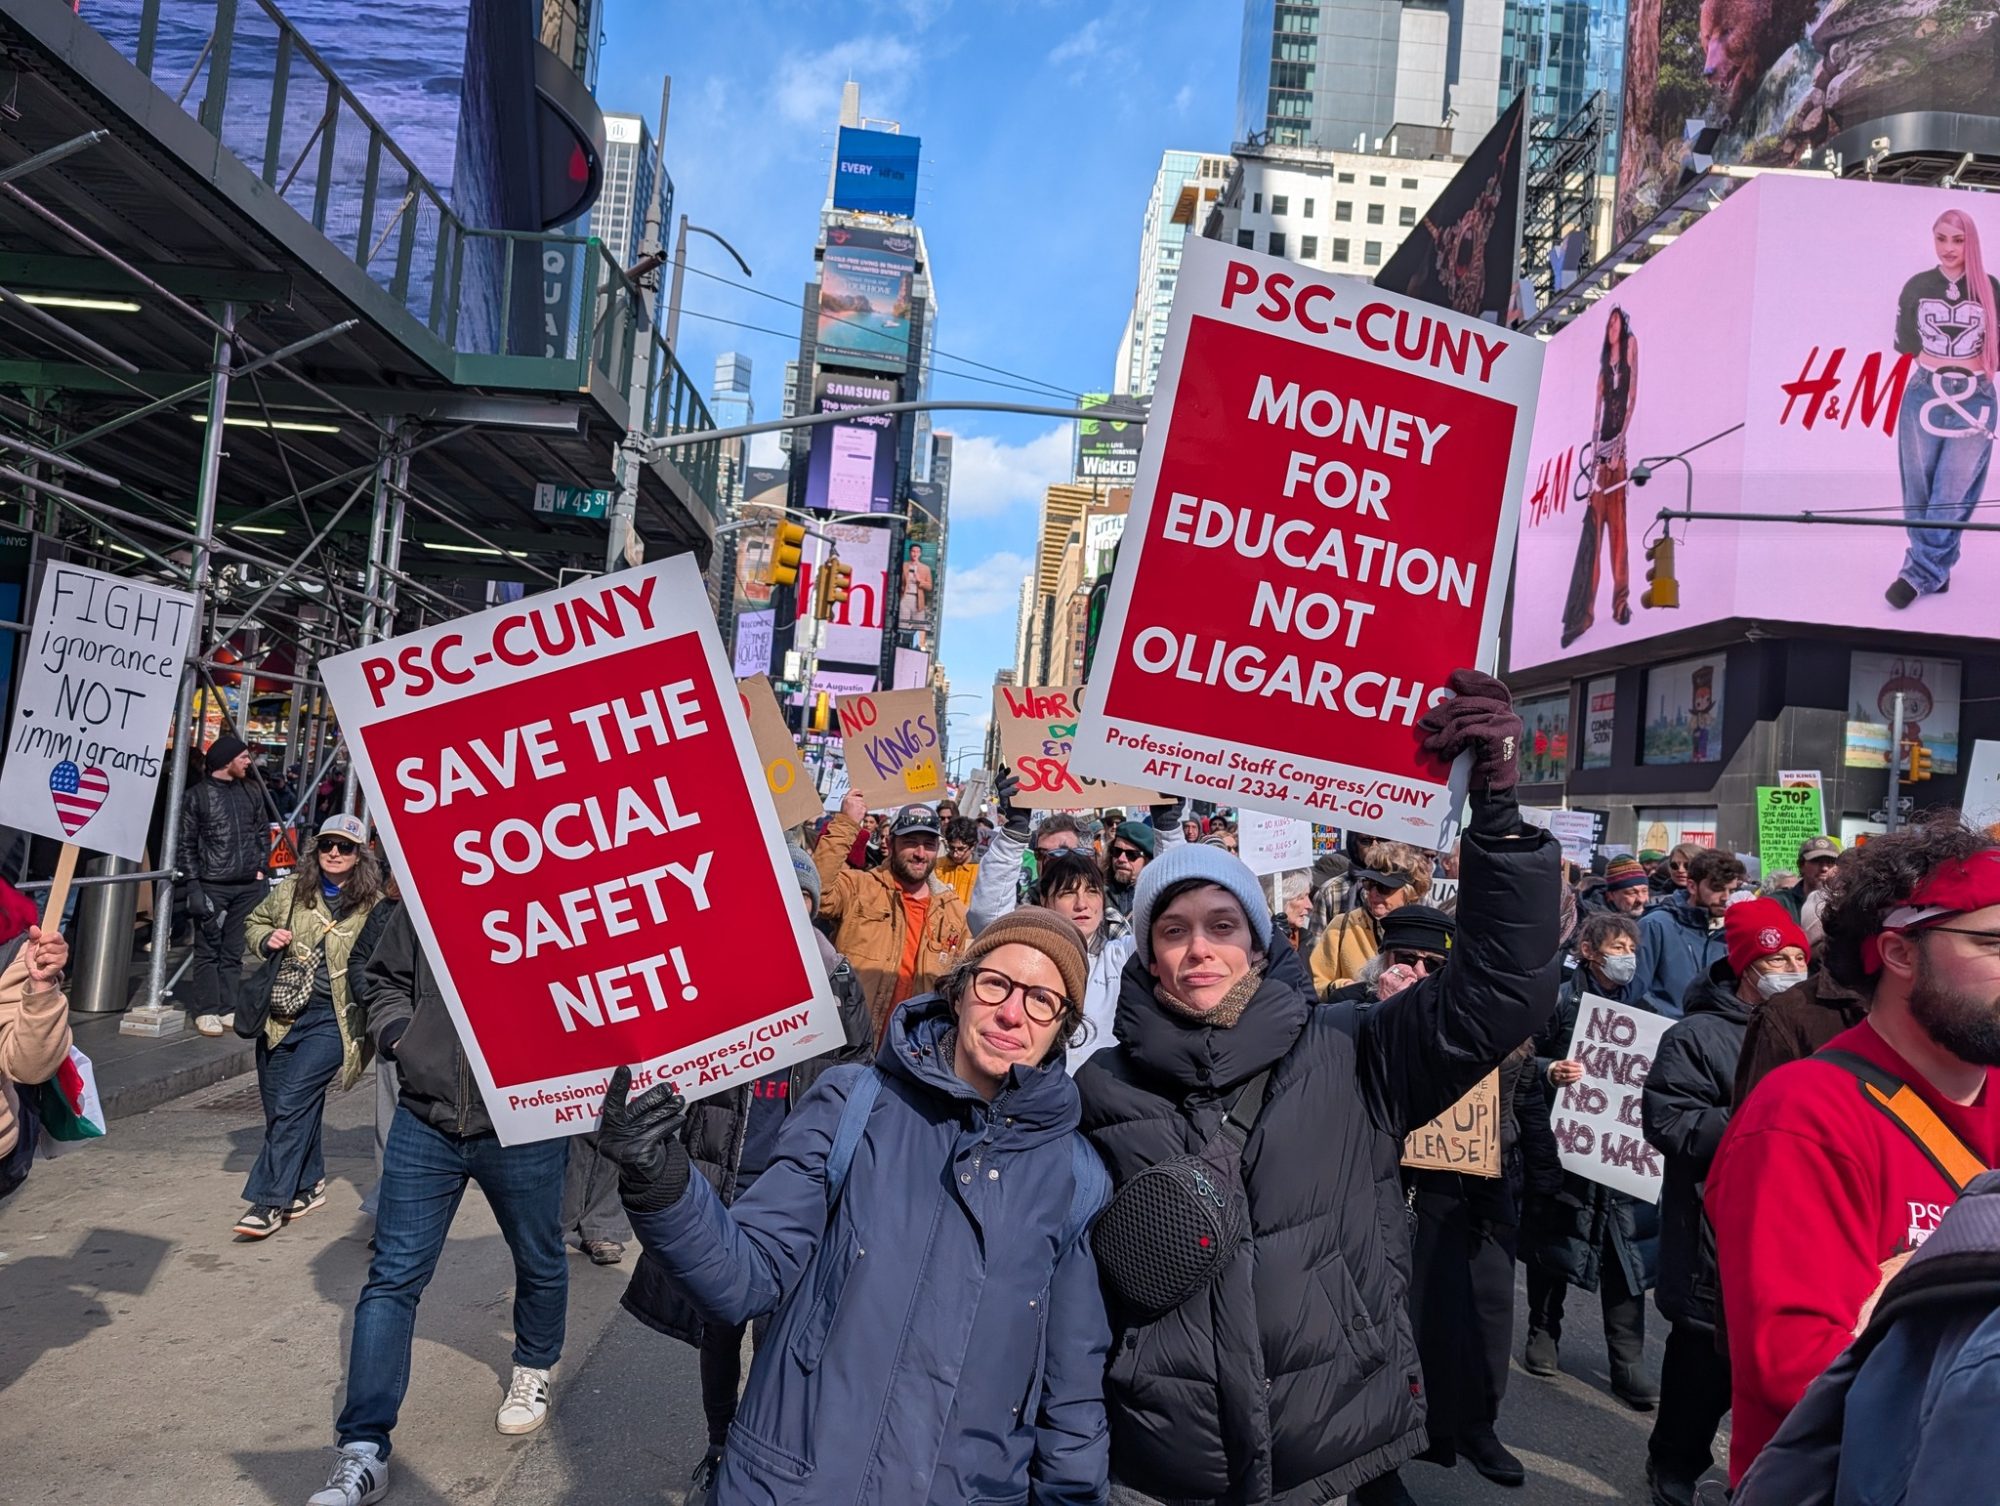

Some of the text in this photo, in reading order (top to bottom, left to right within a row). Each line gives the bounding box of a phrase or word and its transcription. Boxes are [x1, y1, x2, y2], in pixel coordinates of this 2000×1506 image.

[841, 161, 873, 175] EVERY
[1221, 260, 1509, 383] PSC-CUNY
[827, 383, 890, 401] SAMSUNG
[1247, 374, 1451, 466] MONEY
[1780, 346, 1913, 438] H&M
[556, 489, 605, 512] W 45 St
[1283, 451, 1391, 521] FOR
[1529, 445, 1574, 528] H&M
[1095, 517, 1123, 536] LITTL
[1162, 492, 1477, 608] EDUCATION
[53, 570, 194, 646] FIGHT
[1249, 580, 1376, 647] NOT
[41, 621, 172, 678] ignorance
[361, 576, 657, 708] PSC-CUNY
[55, 674, 146, 729] NOT
[826, 682, 863, 693] Augustin
[839, 696, 877, 737] NO
[1003, 687, 1075, 719] WAR
[15, 709, 160, 777] immigrants
[396, 678, 708, 813] SAVE THE
[864, 715, 936, 781] KINGS
[1016, 756, 1083, 794] SEX
[1106, 727, 1435, 809] Professional Staff Congress/CUNY
[1143, 758, 1181, 781] AFT
[1184, 766, 1234, 791] Local
[1239, 778, 1287, 800] 2334
[1304, 791, 1384, 820] AFL-CIO
[1769, 790, 1811, 805] STOP
[453, 776, 701, 886] SOCIAL
[482, 851, 714, 964] SAFETY
[548, 946, 698, 1033] NET!
[509, 1078, 608, 1111] Professional
[628, 1072, 653, 1092] aff
[657, 1010, 809, 1078] Congress/CUNY
[1585, 1007, 1637, 1048] NO
[555, 1107, 583, 1124] AFT
[698, 1046, 775, 1087] AFL-CIO
[1574, 1041, 1654, 1088] KING
[1561, 1083, 1608, 1115] NO
[1553, 1118, 1661, 1177] NO WAR
